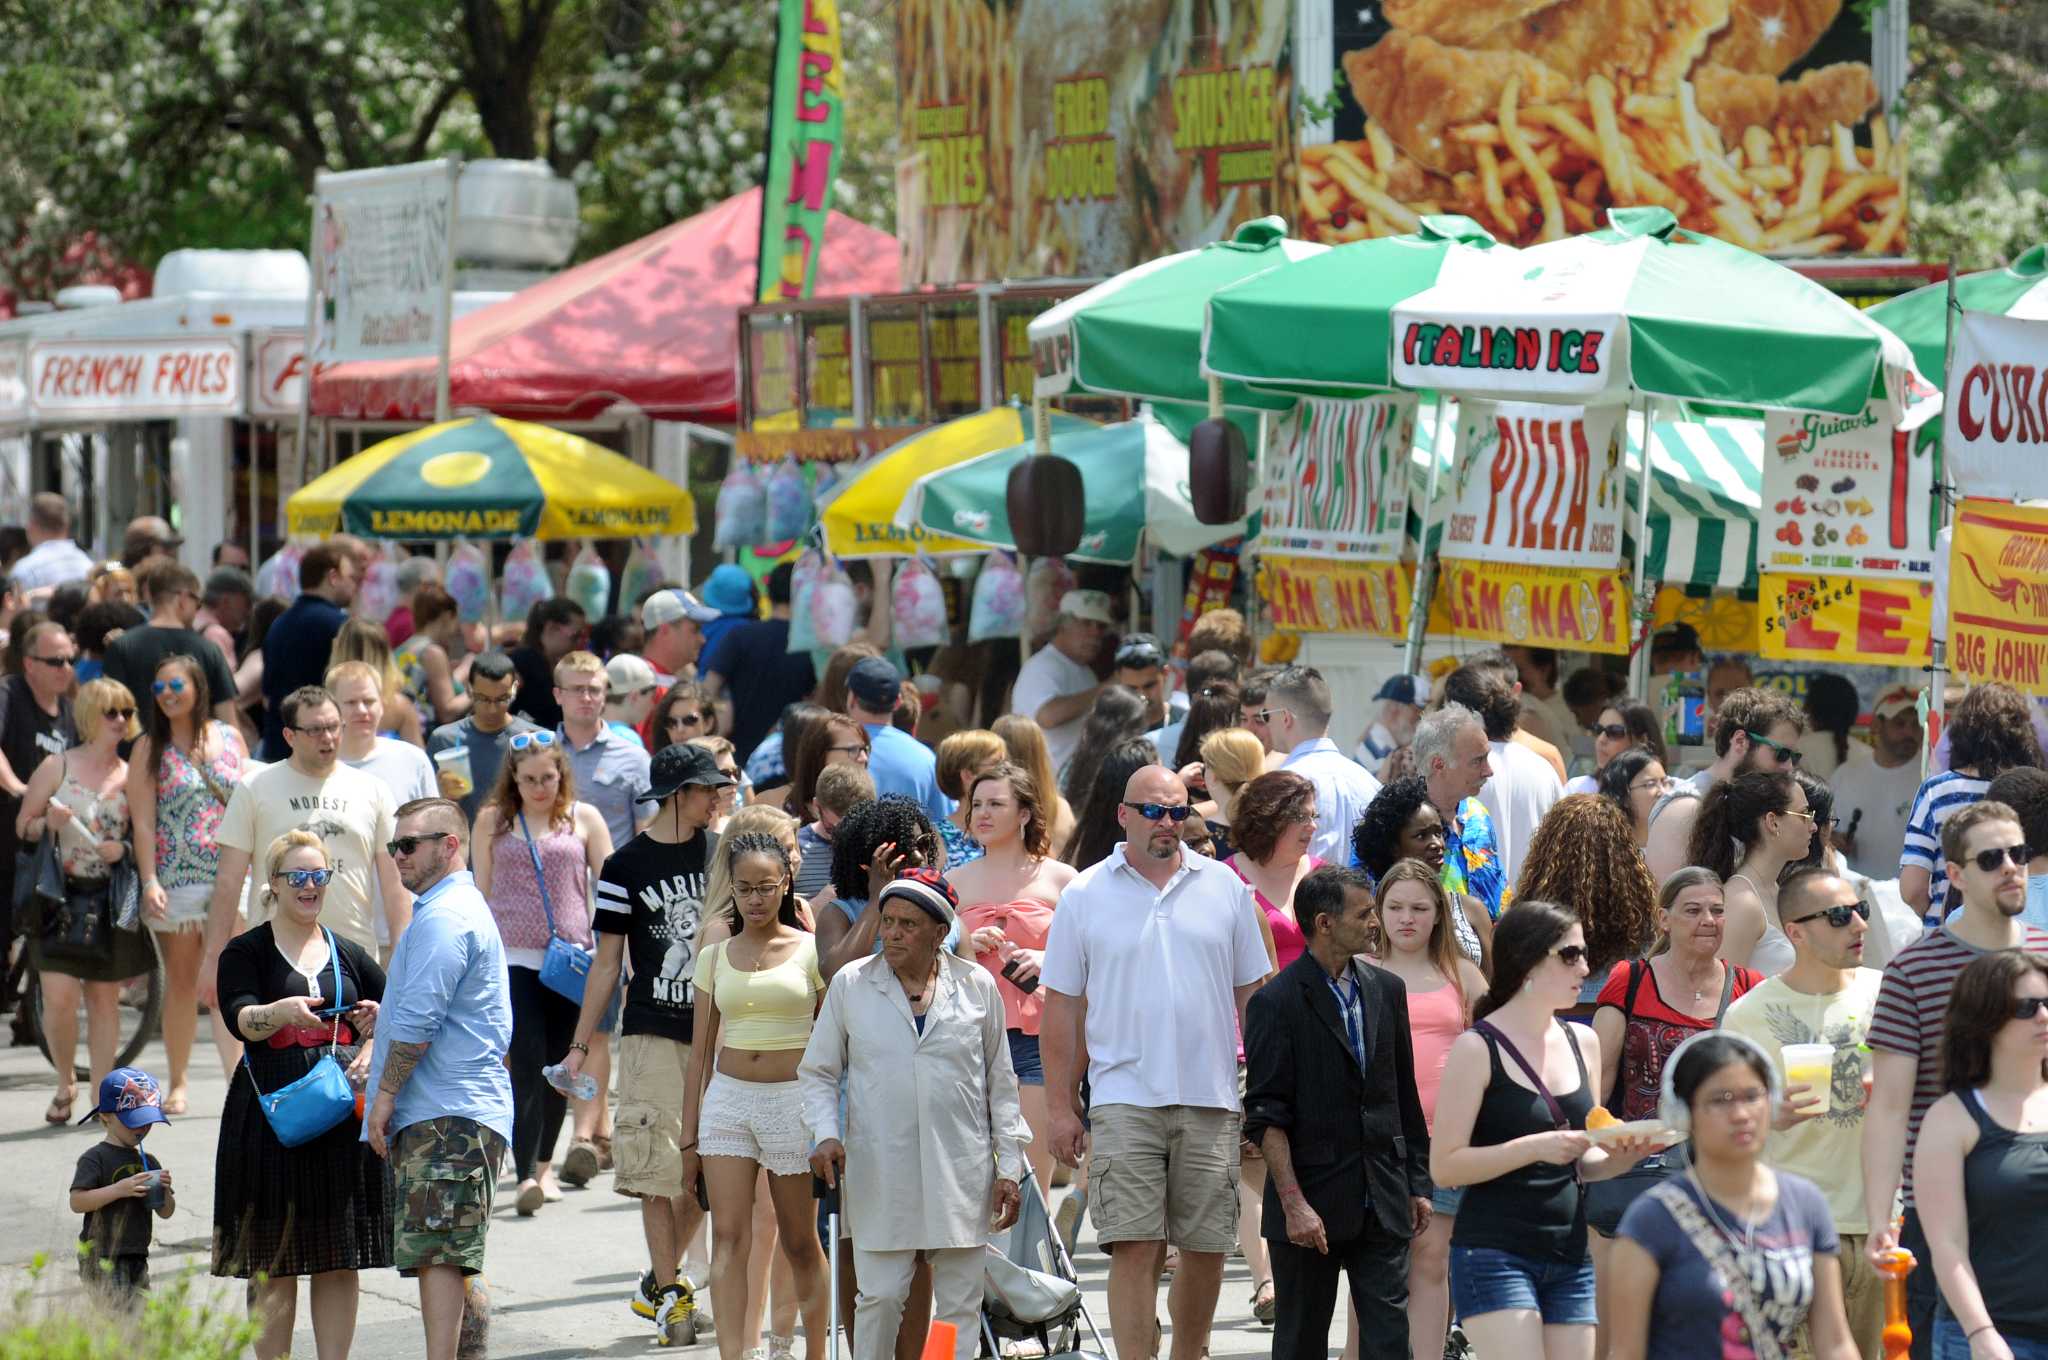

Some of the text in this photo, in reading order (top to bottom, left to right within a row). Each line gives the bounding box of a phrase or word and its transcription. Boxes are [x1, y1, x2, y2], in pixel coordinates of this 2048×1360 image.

[1054, 77, 1110, 137] FRIED
[1173, 66, 1274, 150] SAUSAGE
[917, 134, 986, 206] FRIES
[1045, 138, 1118, 204] DOUGH
[1404, 323, 1604, 373] ITALIAN ICE
[39, 354, 143, 396] FRENCH
[153, 352, 230, 394] FRIES
[1482, 416, 1591, 552] PIZZA
[371, 509, 518, 533] LEMONADE
[567, 506, 672, 526] LEMONADE
[1445, 568, 1616, 644] LEMONADE
[1765, 582, 1853, 632] Squeezed
[1777, 576, 1828, 611] Fresh
[1956, 632, 1986, 677] BIG
[289, 795, 348, 813] MODEST
